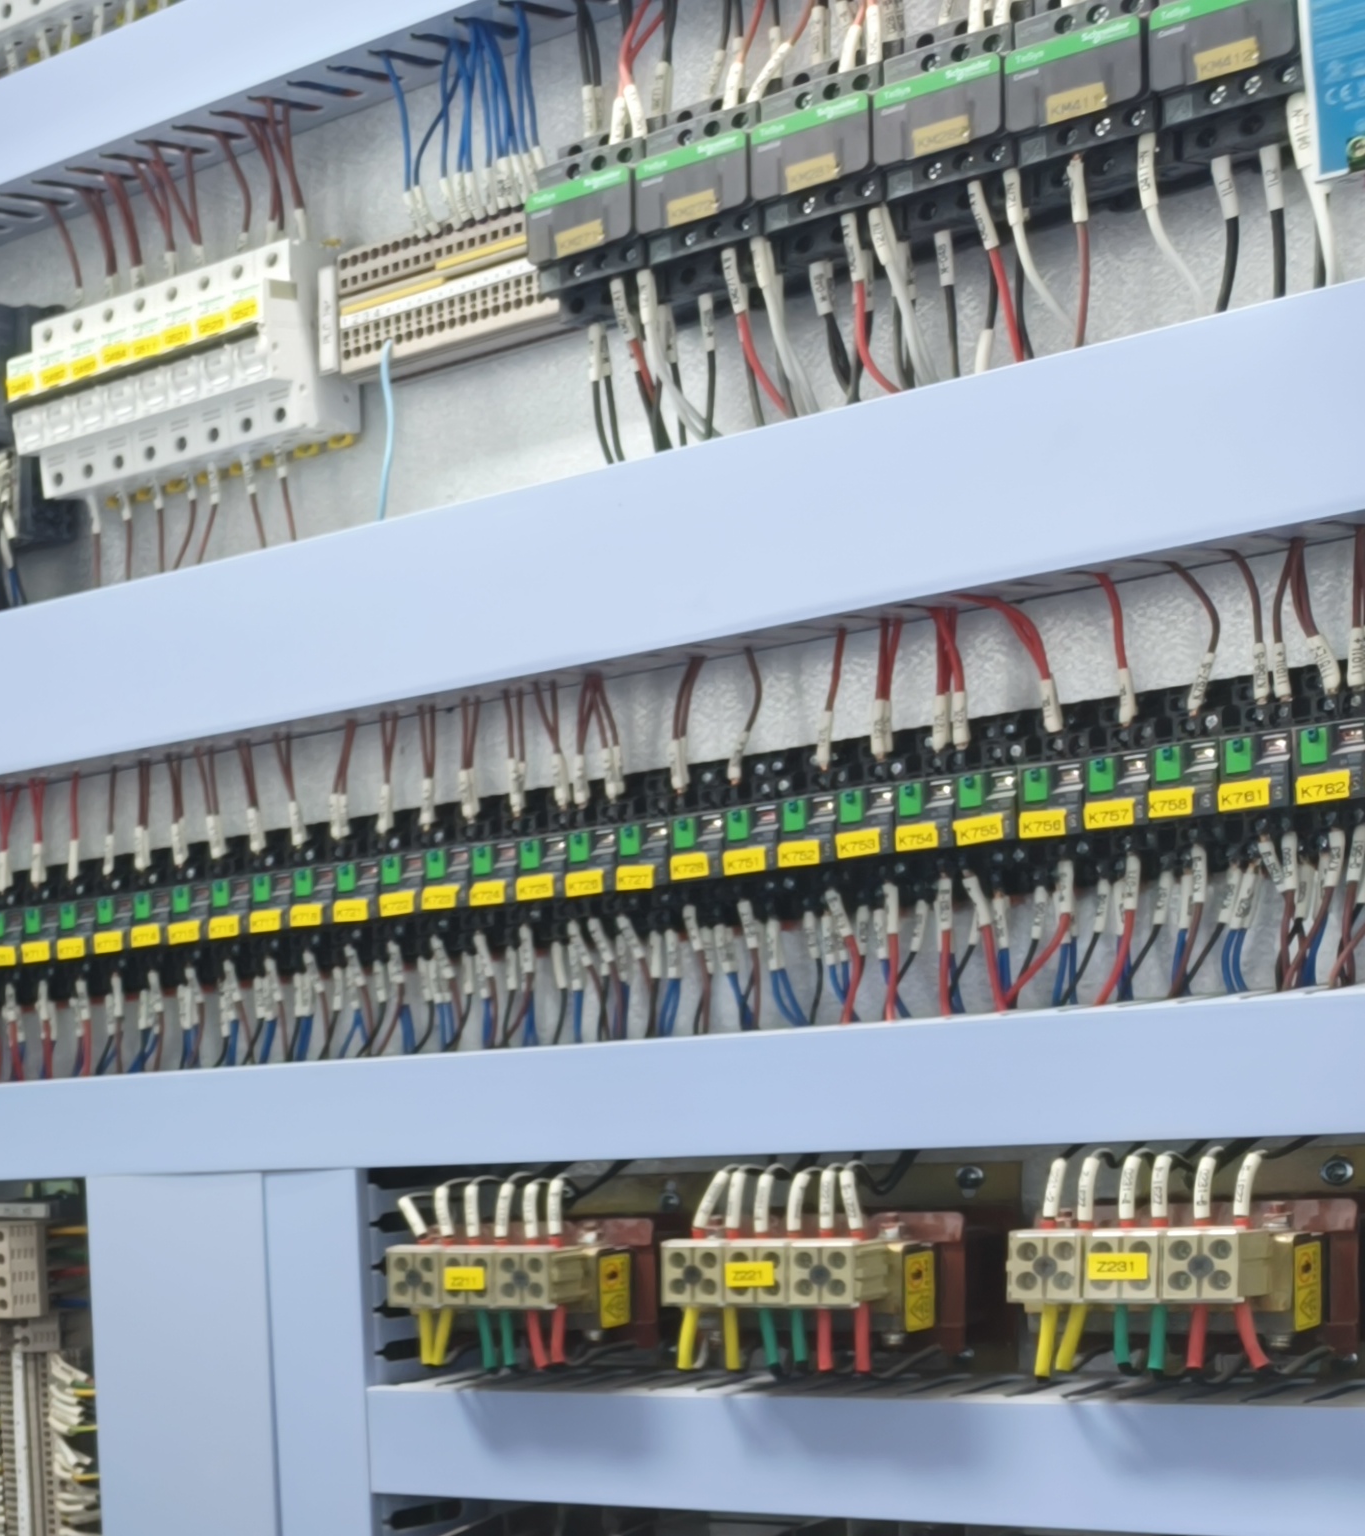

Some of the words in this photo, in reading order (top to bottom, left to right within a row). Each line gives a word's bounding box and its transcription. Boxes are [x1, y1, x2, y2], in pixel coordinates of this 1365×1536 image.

[1301, 781, 1346, 798] K762
[1150, 797, 1188, 812] K758
[1222, 789, 1262, 806] K761
[1089, 808, 1130, 823] K757
[959, 825, 999, 841] K755
[1023, 819, 1062, 833] K756
[899, 833, 933, 846] K754
[727, 857, 759, 870] K751
[781, 850, 815, 863] K752
[1096, 1261, 1135, 1273] Z231
[732, 1269, 763, 1281] Z221
